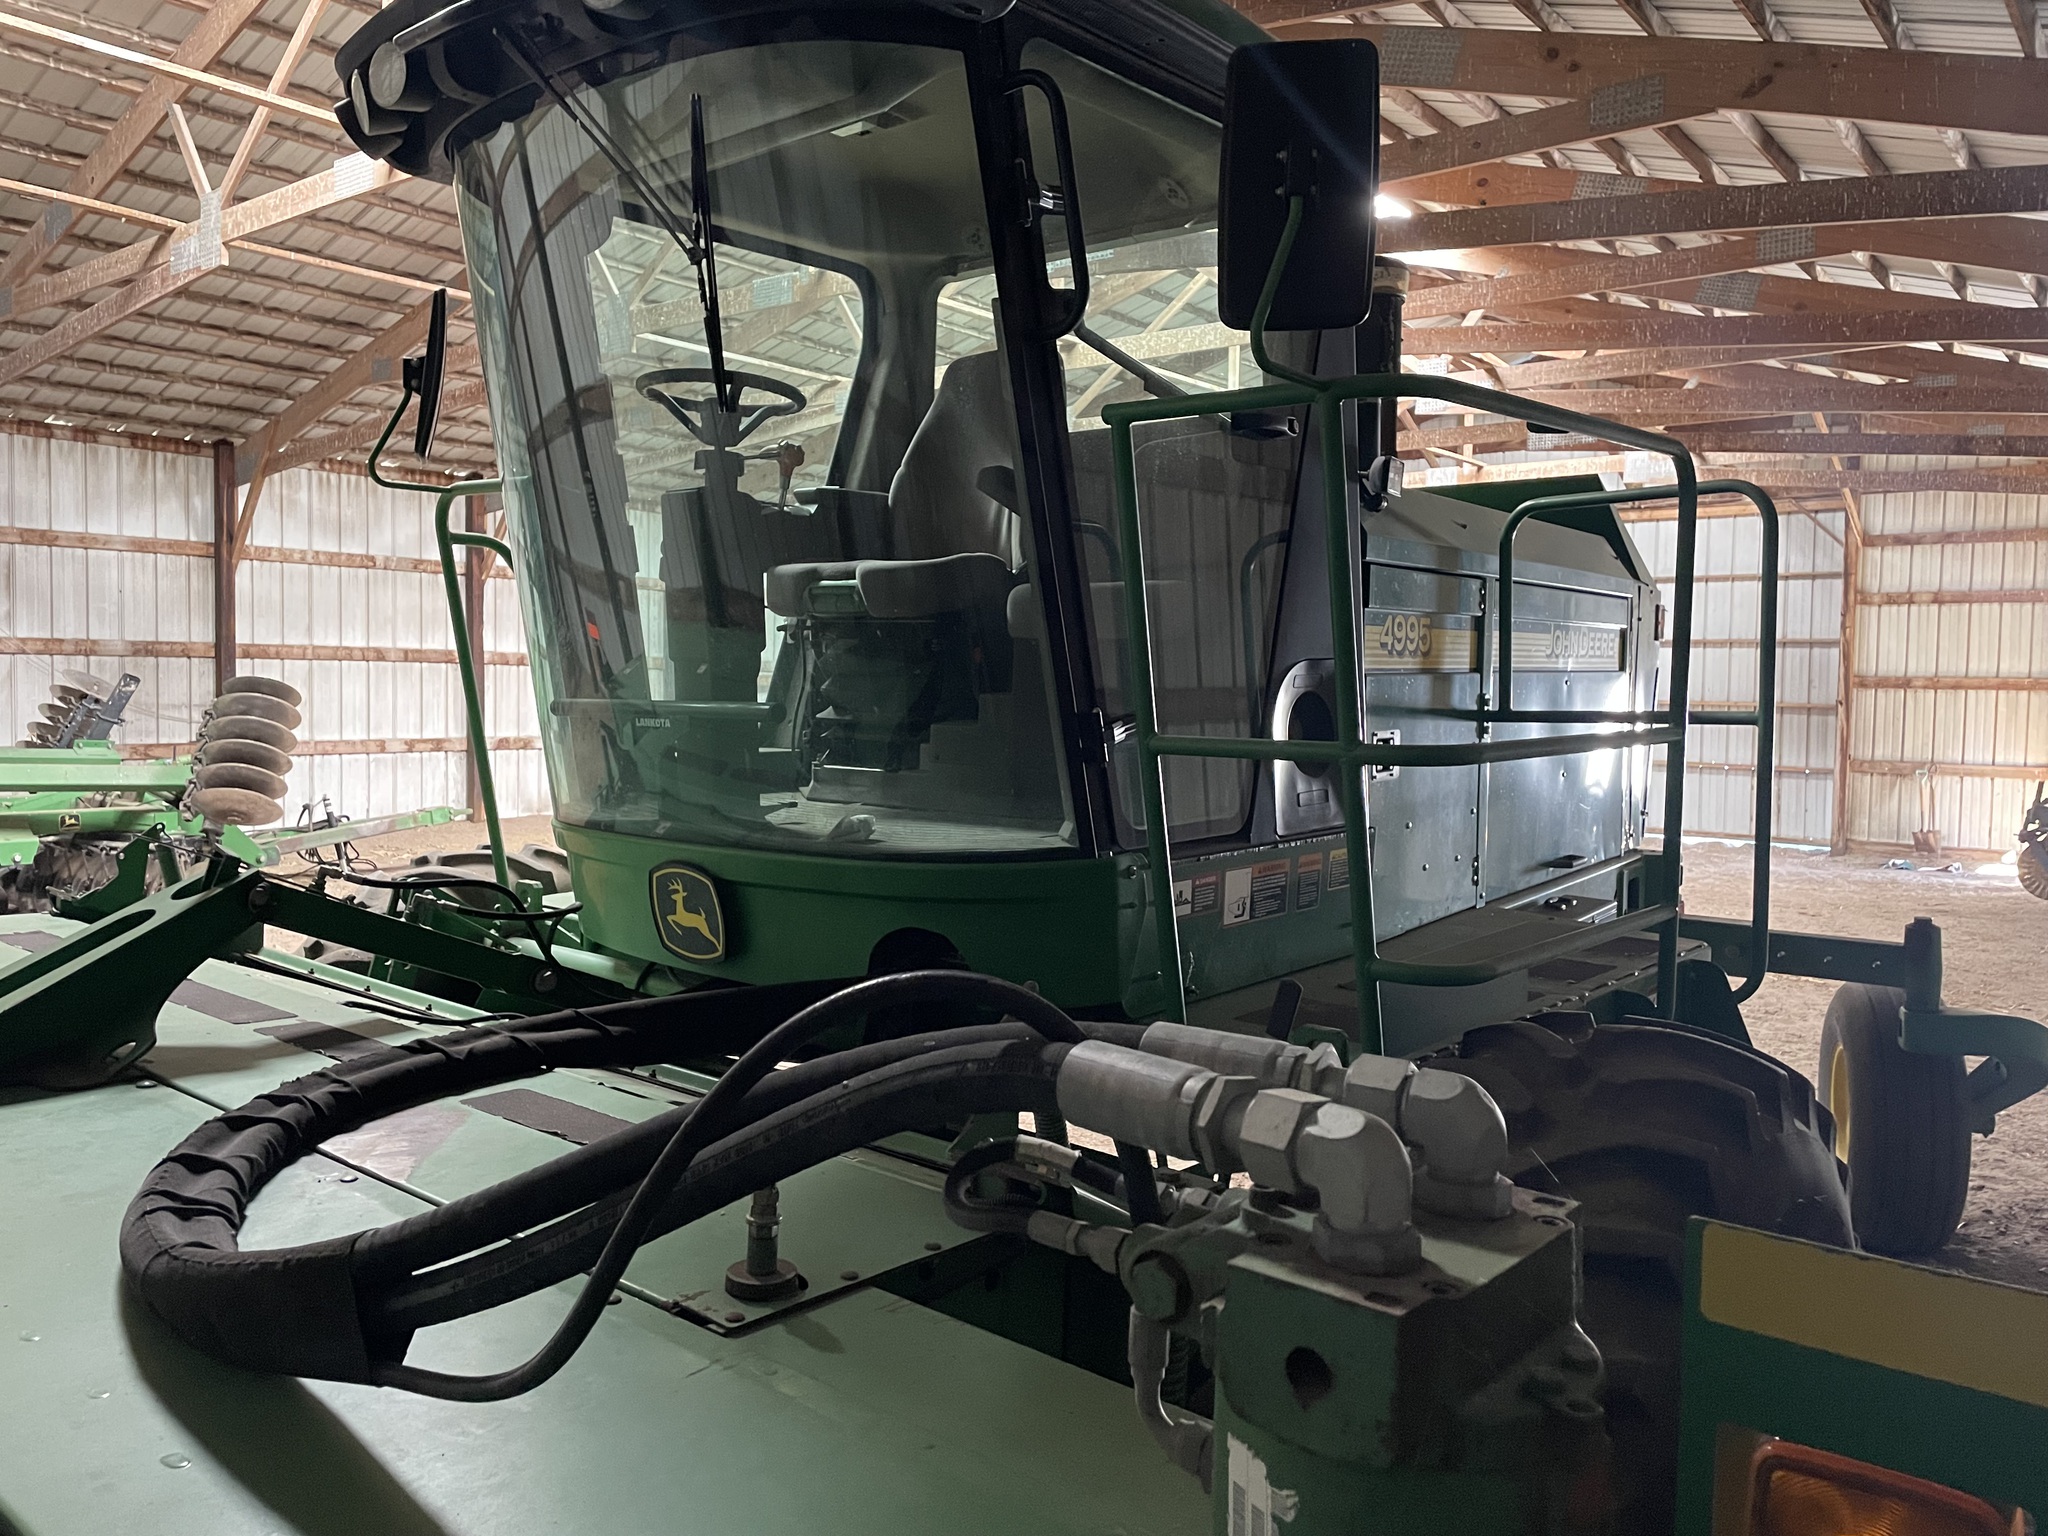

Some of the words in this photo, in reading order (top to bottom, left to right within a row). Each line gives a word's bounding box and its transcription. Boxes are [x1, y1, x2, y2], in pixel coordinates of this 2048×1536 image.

[1380, 614, 1432, 658] 4995
[1546, 622, 1579, 657] JOHN
[1579, 627, 1616, 657] DEERE
[635, 717, 671, 728] LANKOTA
